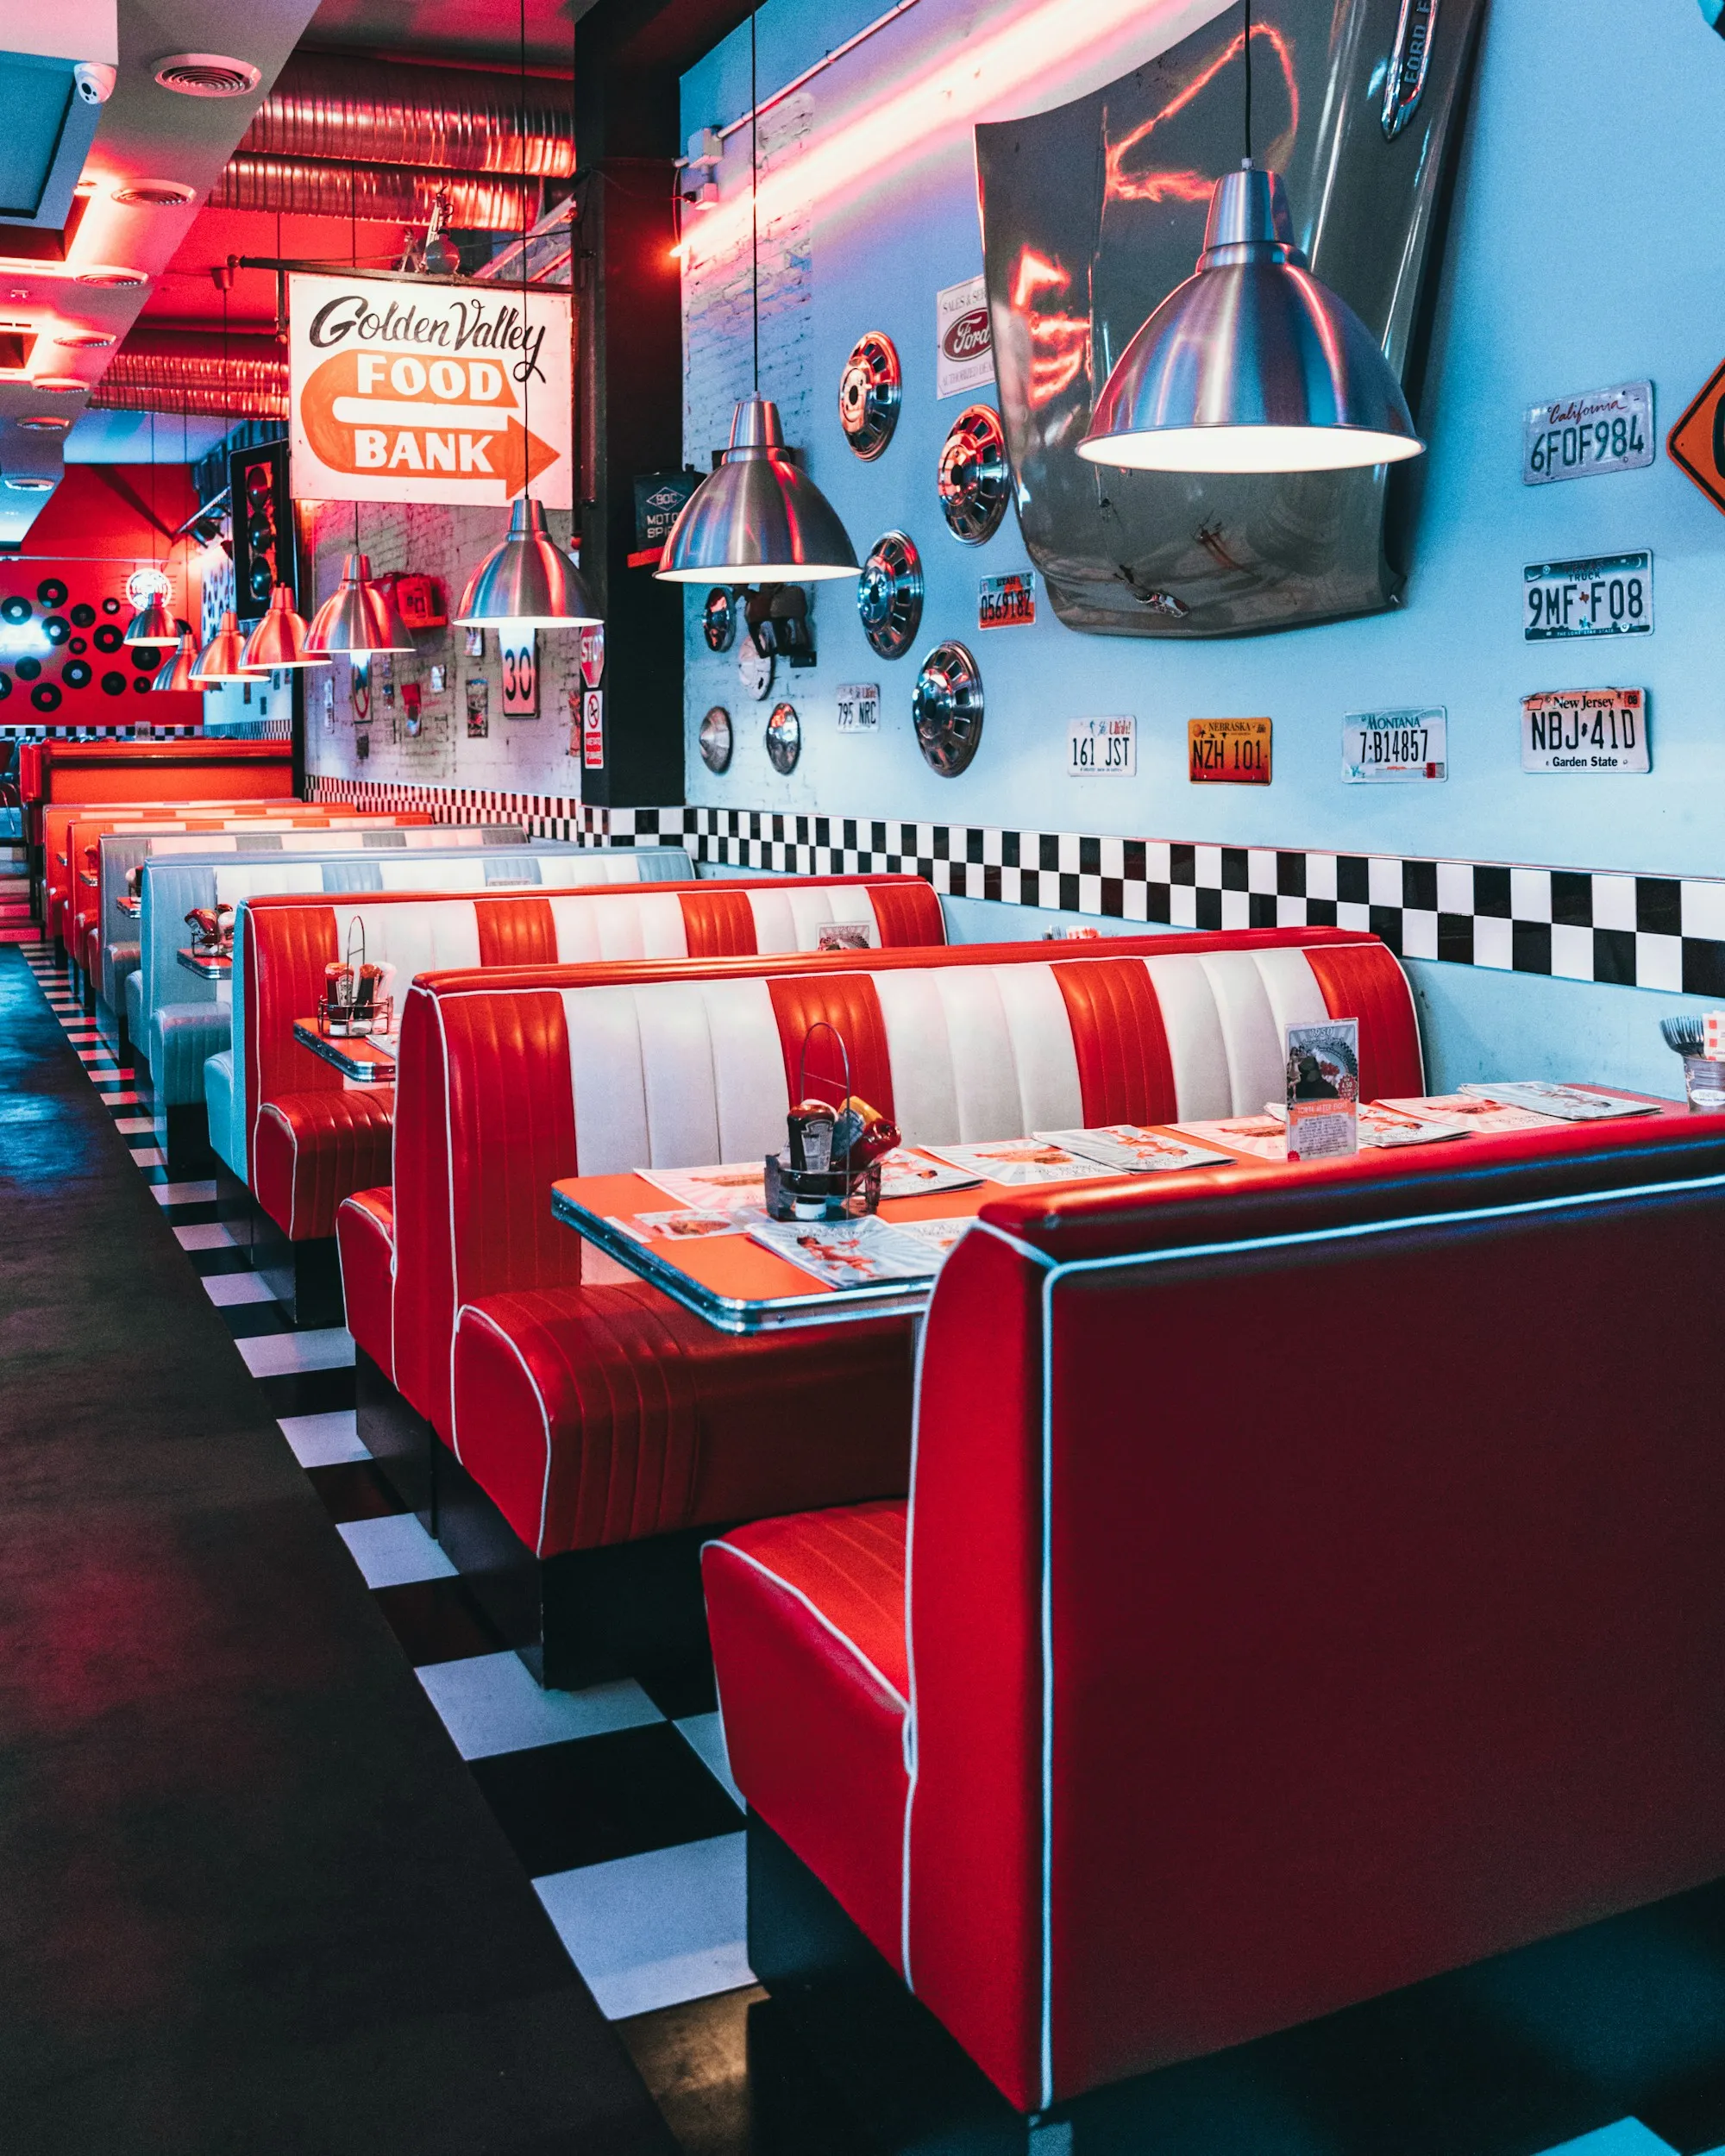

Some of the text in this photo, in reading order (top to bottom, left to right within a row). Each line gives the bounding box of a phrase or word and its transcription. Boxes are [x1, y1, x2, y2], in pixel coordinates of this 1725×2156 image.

[309, 295, 546, 384] Golden Valley
[953, 316, 990, 354] Ford
[357, 353, 502, 401] FOOD
[1549, 399, 1628, 424] California
[354, 429, 495, 473] BANK
[1568, 571, 1601, 582] TRUCK
[505, 647, 532, 701] 30
[838, 701, 876, 725] 795 NRC
[1553, 695, 1615, 711] New Jersey
[1208, 722, 1251, 732] NEBRASKA
[1366, 713, 1421, 730] MONTANA
[1072, 736, 1129, 767] 161 JST
[1193, 739, 1261, 770] NZH 101
[1552, 755, 1618, 767] Garden State
